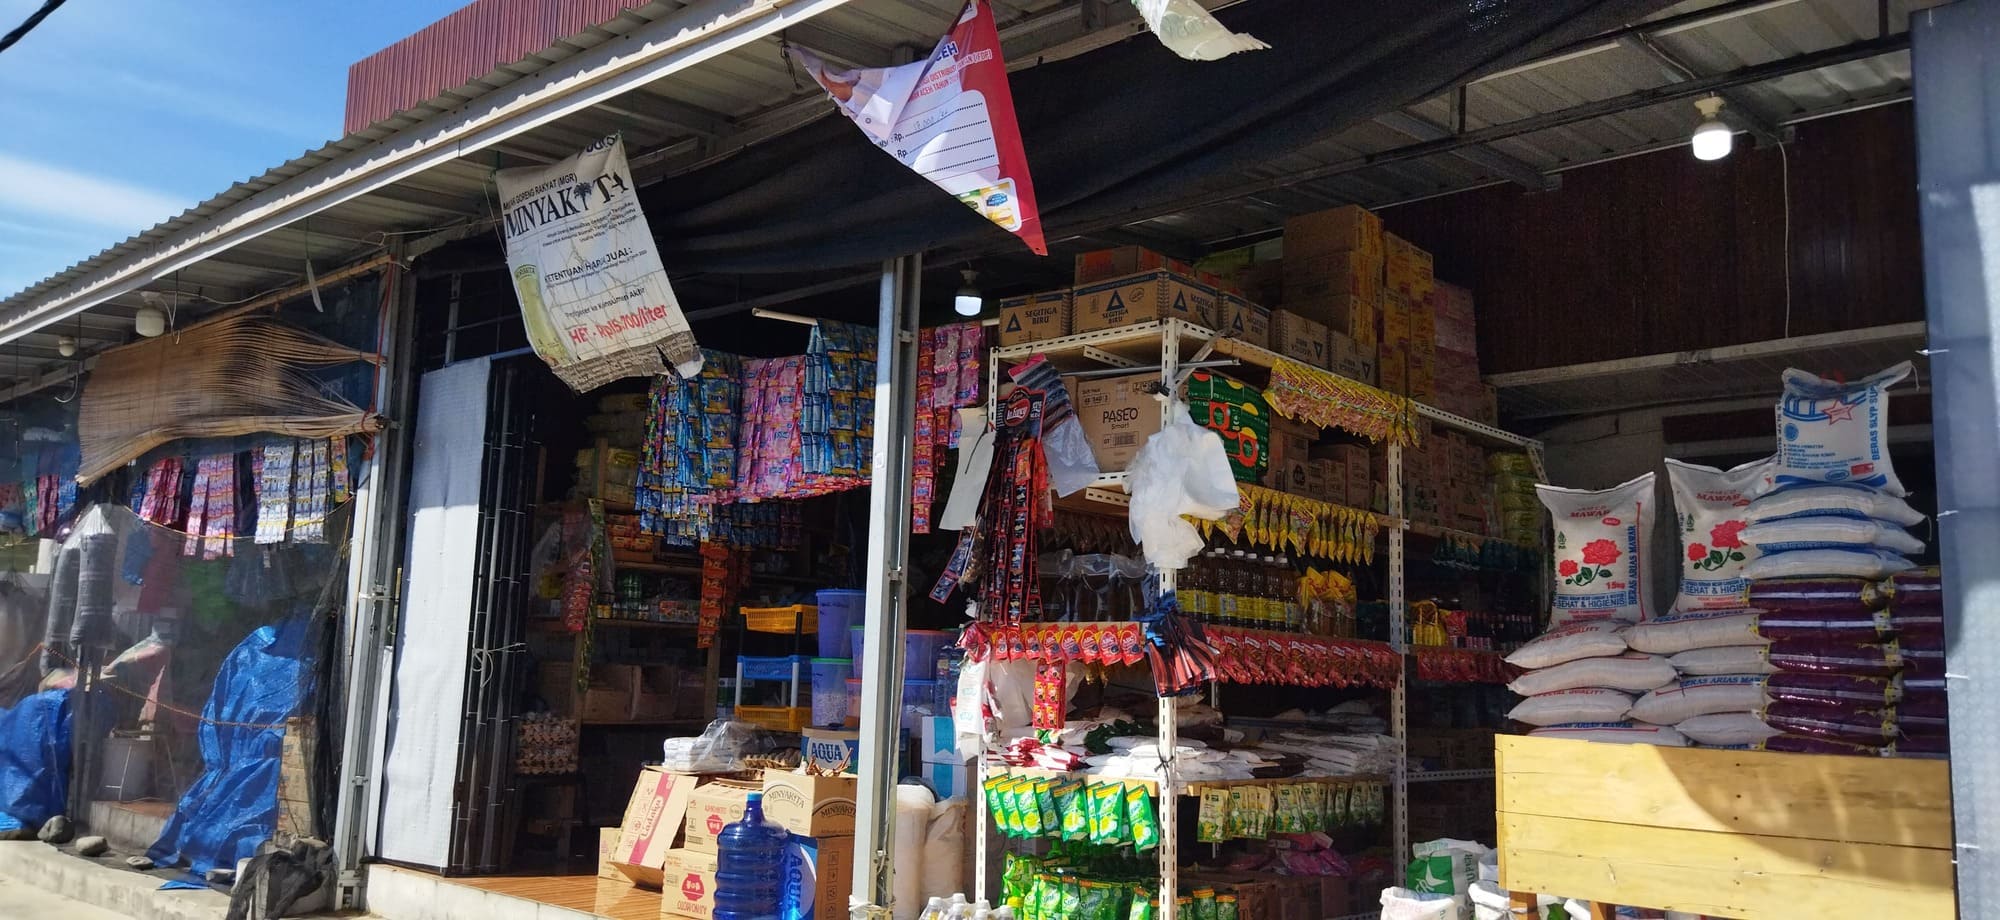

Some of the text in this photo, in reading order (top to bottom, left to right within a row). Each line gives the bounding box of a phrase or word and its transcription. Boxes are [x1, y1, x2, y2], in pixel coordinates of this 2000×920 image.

[920, 87, 933, 97] ACEH
[933, 80, 949, 91] TAHUN
[535, 179, 557, 194] RAKYAT
[558, 172, 578, 186] (MGR)
[545, 264, 584, 283] KETENTUAN
[1025, 306, 1057, 318] SEGITIGA
[1032, 316, 1049, 325] BIRU
[1102, 407, 1138, 424] PASEO
[1111, 422, 1130, 430] Smart
[1871, 429, 1881, 460] BERAS
[1627, 525, 1638, 605] BERAS ARIAS MAWAR
[1685, 585, 1708, 594] SEHAT
[1711, 585, 1718, 594] &
[1720, 583, 1745, 593] HIGIE
[1588, 598, 1625, 608] HIGIENIS
[1711, 676, 1739, 684] ARIAS
[811, 742, 843, 763] AQUA
